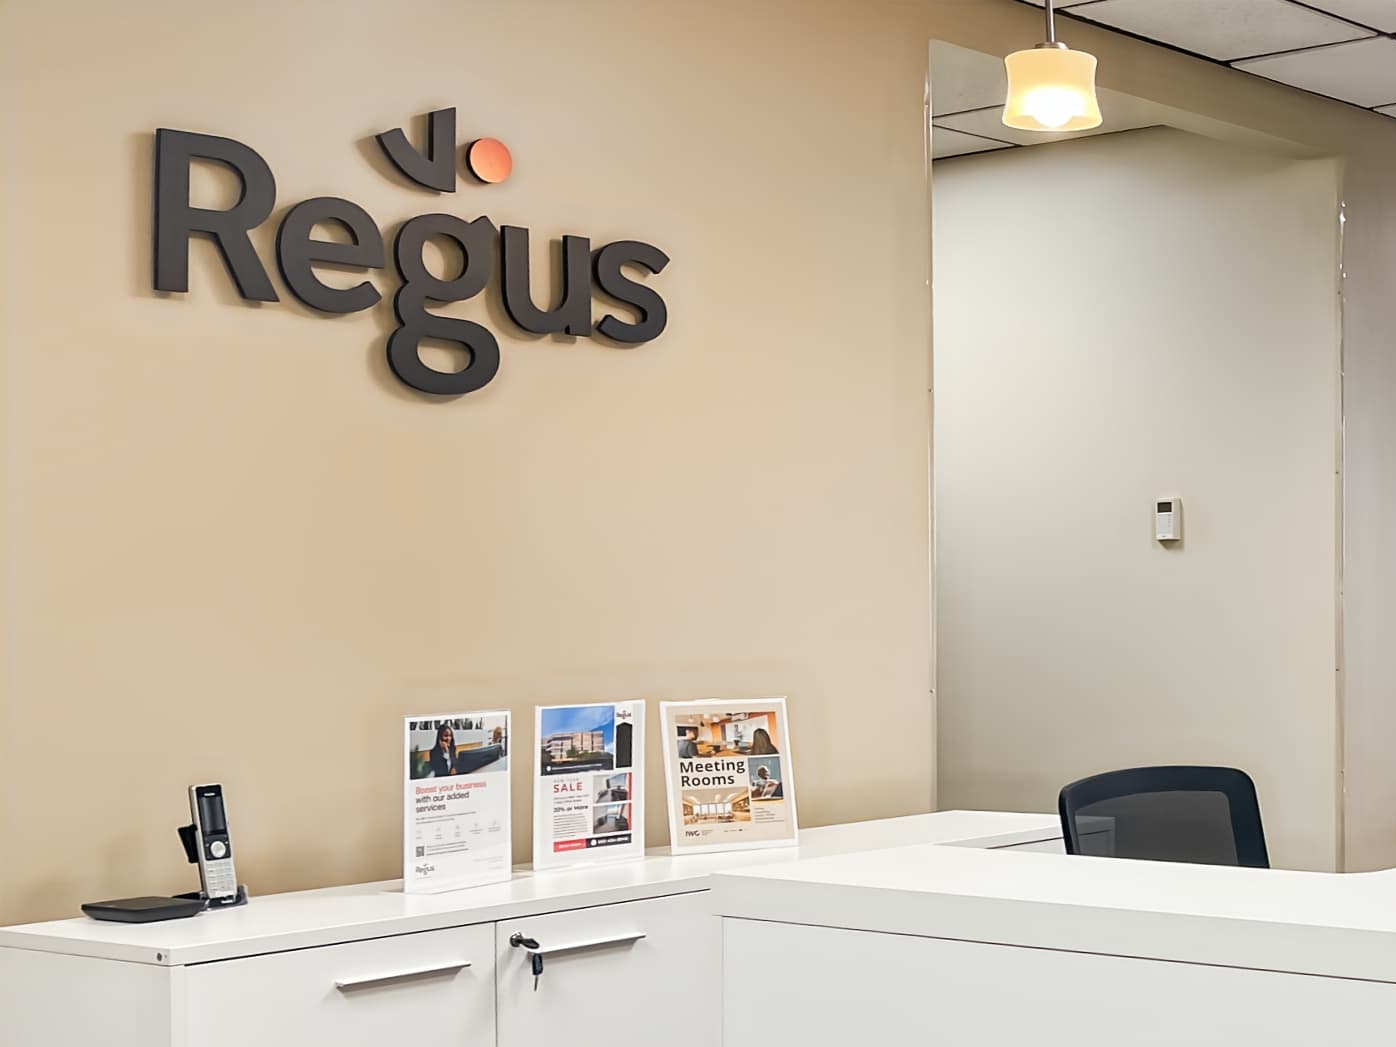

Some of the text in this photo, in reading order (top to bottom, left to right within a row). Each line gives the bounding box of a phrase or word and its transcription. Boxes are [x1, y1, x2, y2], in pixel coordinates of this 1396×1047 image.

[153, 127, 670, 395] Regus
[680, 760, 746, 774] Meeting
[681, 775, 735, 787] Rooms
[439, 784, 454, 794] your
[553, 782, 583, 793] SALE
[416, 791, 470, 804] with our added
[416, 804, 446, 813] services
